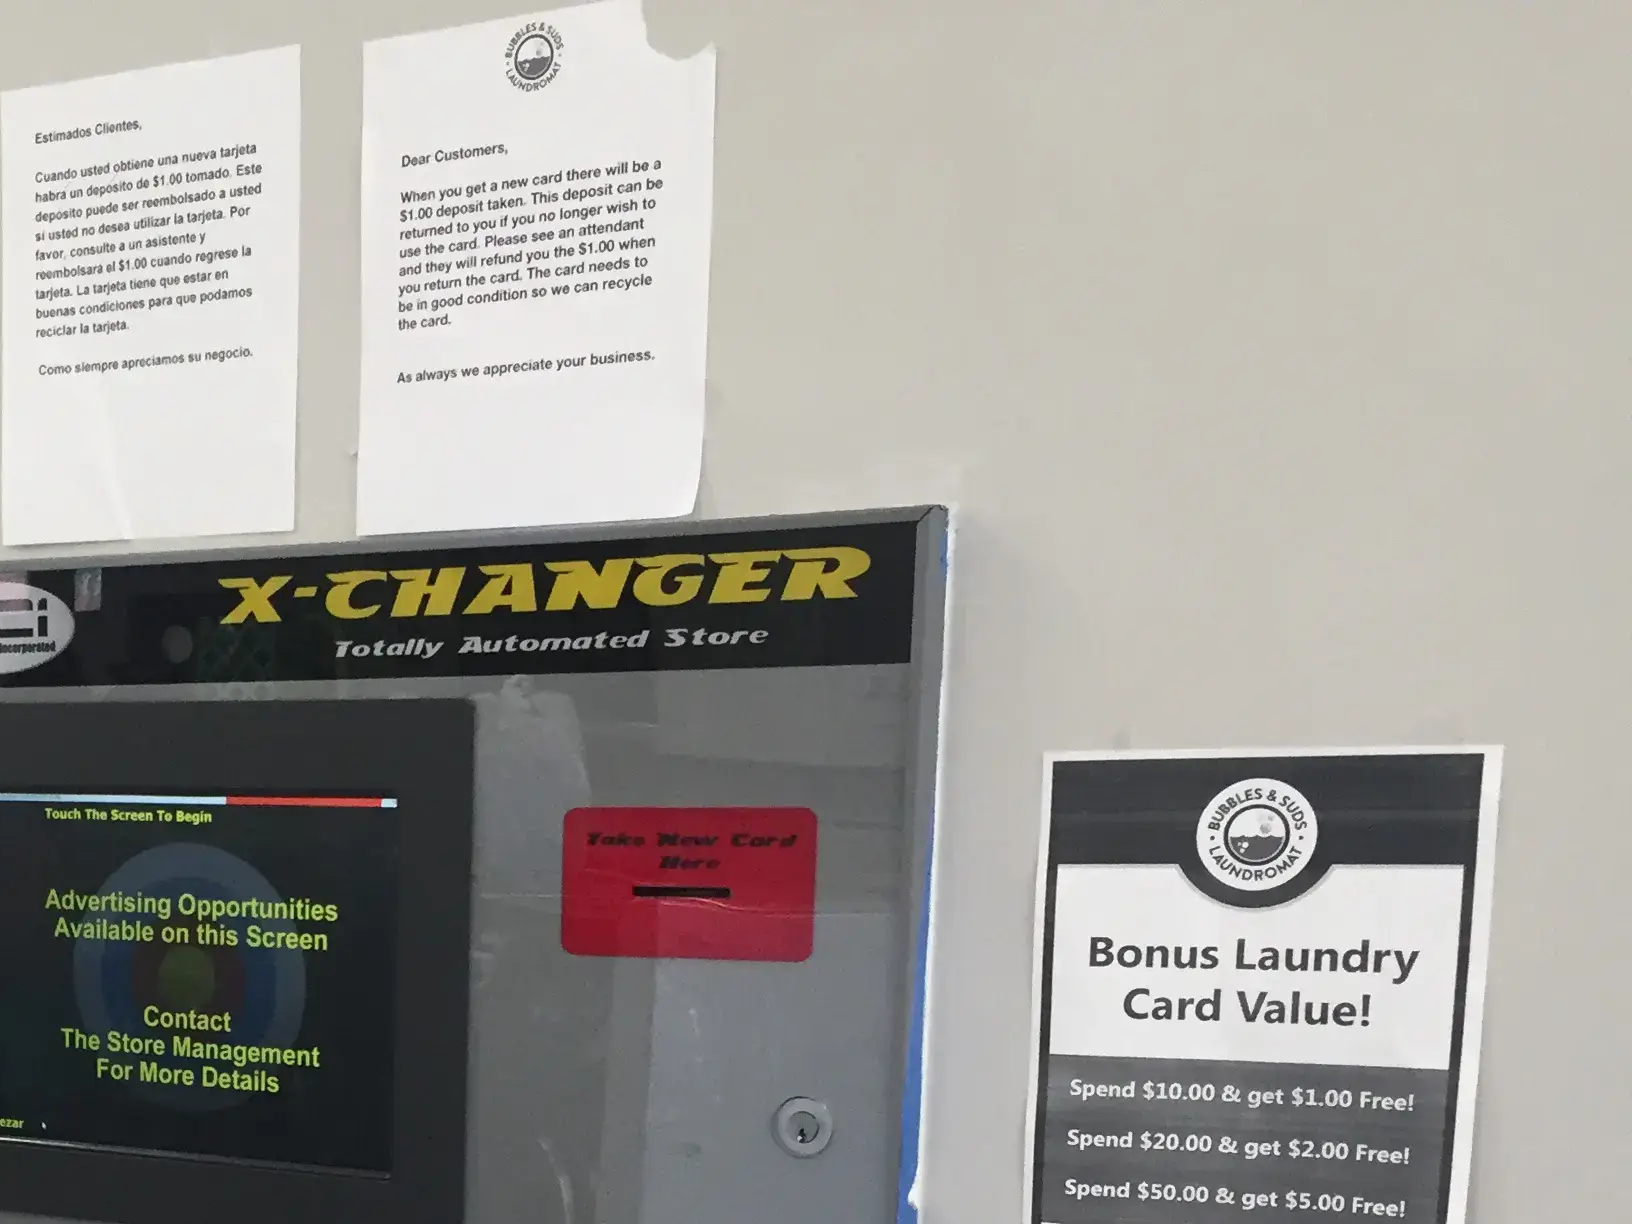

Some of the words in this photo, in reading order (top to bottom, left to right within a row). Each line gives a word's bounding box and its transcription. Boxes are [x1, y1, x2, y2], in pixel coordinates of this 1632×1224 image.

[504, 22, 537, 58] BUBBLES
[538, 22, 545, 31] &
[546, 25, 564, 50] SUDS
[505, 61, 562, 92] LAUNDROMAT
[401, 154, 431, 168] Dear
[434, 143, 508, 163] Customers,
[400, 190, 436, 204] When
[439, 187, 462, 202] you
[465, 181, 487, 198] get
[489, 181, 498, 192] a
[501, 178, 529, 190] new
[532, 169, 563, 186] card
[566, 167, 602, 182] there
[605, 161, 629, 177] will
[632, 160, 650, 173] be
[653, 159, 662, 171] a
[399, 206, 433, 223] $1.00
[436, 200, 484, 219] deposit
[487, 196, 526, 211] taken.
[531, 191, 559, 205] This
[562, 183, 613, 202] deposit
[616, 181, 642, 195] can
[646, 178, 664, 191] be
[396, 372, 413, 384] As
[415, 368, 458, 382] always
[460, 366, 480, 377] we
[482, 358, 553, 378] appreciate
[556, 356, 587, 372] your
[590, 350, 655, 366] business.
[217, 546, 871, 625] X-CHANGER
[335, 638, 444, 660] Totally
[458, 629, 650, 654] Automated
[664, 627, 769, 648] Store
[44, 807, 82, 820] Touch
[84, 808, 108, 821] The
[110, 808, 154, 822] Screen
[156, 809, 173, 822] To
[175, 810, 212, 826] Begin
[1208, 788, 1263, 831] BUBBLES
[1266, 789, 1277, 802] &
[1278, 795, 1308, 831] SUDS
[1209, 845, 1303, 882] LAUNDROMAT
[45, 888, 171, 920] Advertising
[178, 893, 338, 922] Opportunities
[54, 916, 154, 942] Available
[161, 926, 189, 944] on
[196, 923, 239, 946] this
[246, 924, 328, 951] Screen
[1089, 936, 1219, 970] Bonus
[1235, 938, 1421, 985] Laundry
[143, 1005, 232, 1033] Contact
[1123, 987, 1222, 1022] Card
[1236, 990, 1371, 1027] Value!
[60, 1027, 101, 1051] The
[107, 1030, 165, 1056] Store
[173, 1035, 320, 1068] Management
[97, 1057, 134, 1081] For
[140, 1060, 195, 1086] More
[202, 1065, 280, 1093] Details
[1069, 1078, 1136, 1101] Spend
[1142, 1080, 1216, 1101] $10.00
[1221, 1084, 1241, 1103] &
[1247, 1089, 1284, 1109] get
[1291, 1086, 1353, 1108] $1.00
[1360, 1091, 1414, 1112] Free!
[1067, 1129, 1133, 1151] Spend
[1140, 1130, 1212, 1153] $20.00
[1218, 1135, 1238, 1154] &
[1244, 1140, 1281, 1160] get
[1288, 1138, 1349, 1160] $2.00
[1355, 1143, 1410, 1165] Free!
[1064, 1178, 1130, 1200] Spend
[1137, 1181, 1209, 1203] $50.00
[1215, 1187, 1235, 1205] &
[1241, 1191, 1279, 1211] get
[1285, 1190, 1345, 1212] $5.00
[1352, 1196, 1406, 1218] Free!
